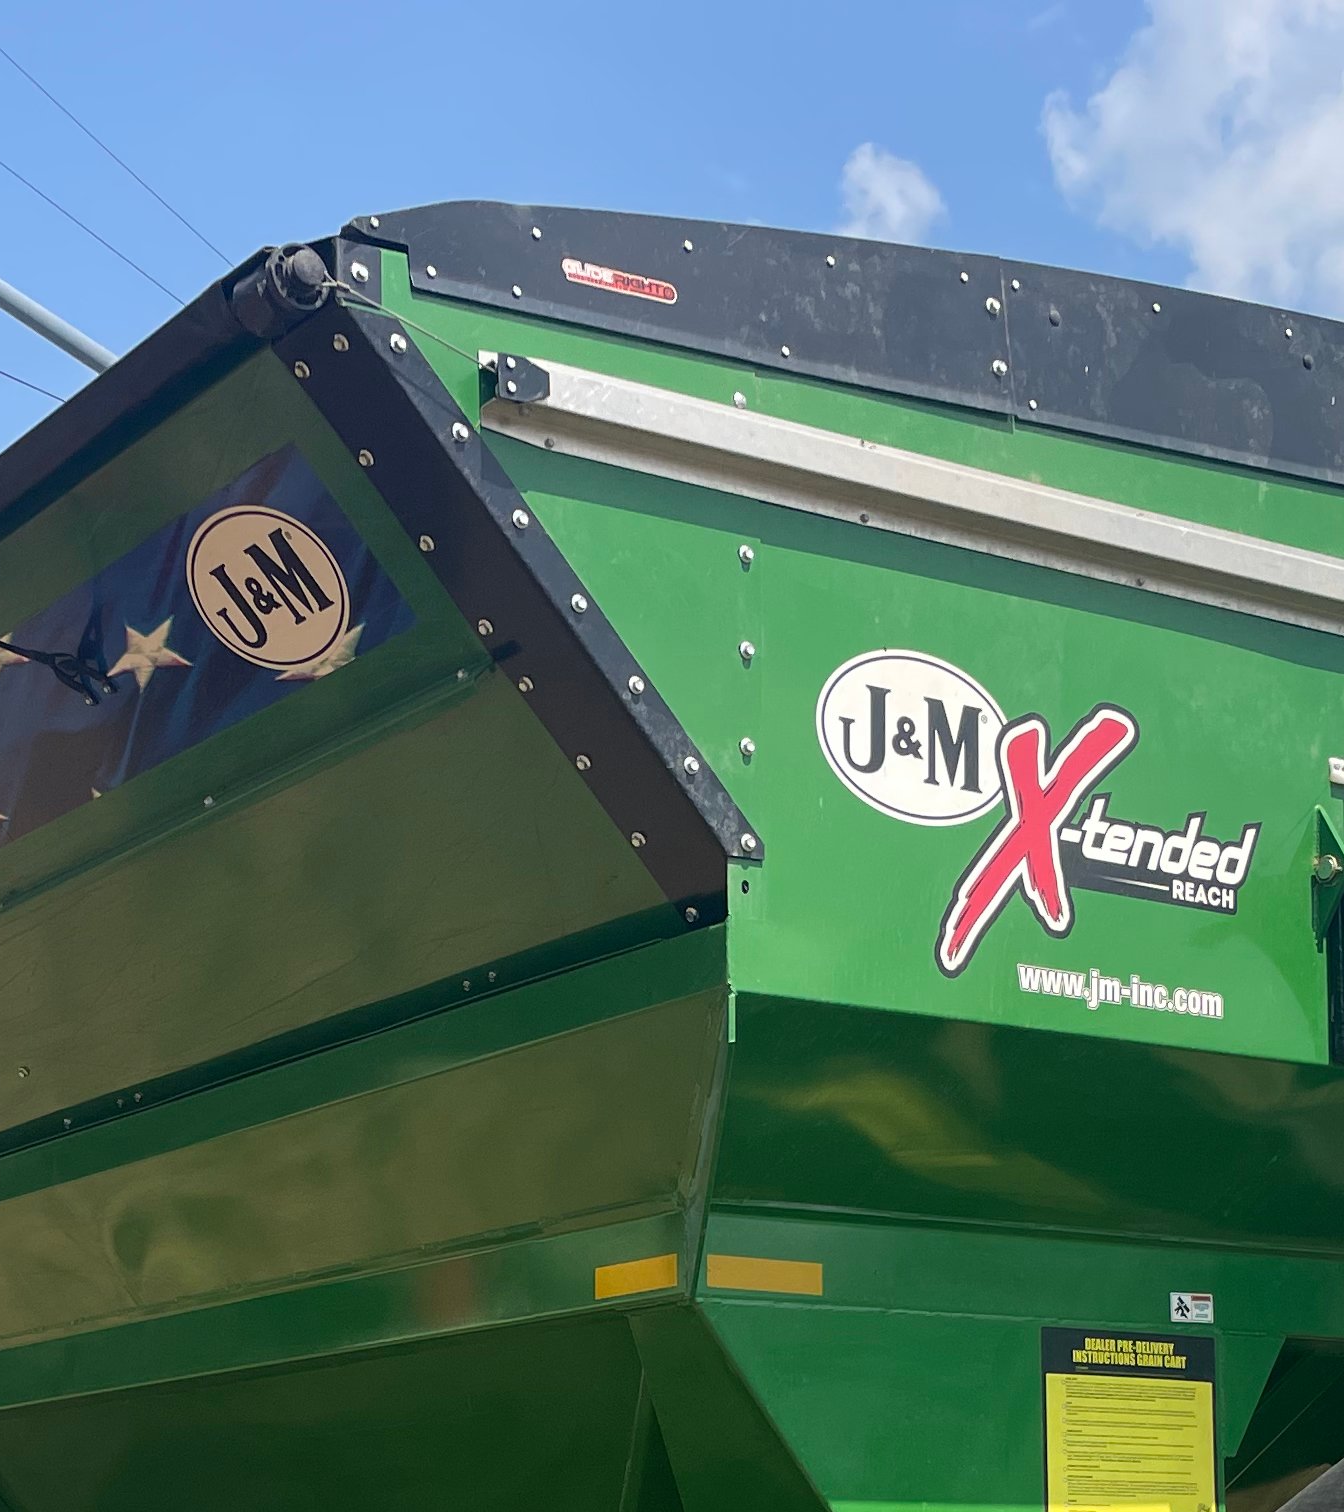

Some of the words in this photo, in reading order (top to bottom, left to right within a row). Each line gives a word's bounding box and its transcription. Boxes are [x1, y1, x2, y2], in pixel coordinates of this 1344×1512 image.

[208, 527, 334, 648] J&M
[838, 685, 984, 794] J&M
[1172, 880, 1235, 909] REACH
[1017, 963, 1224, 1019] www.jm-inc.com
[1072, 1350, 1136, 1366] INSTRUCTIONS
[1137, 1353, 1163, 1367] GRAIN
[1164, 1356, 1187, 1369] CART
[1084, 1337, 1116, 1351] DEALER
[1117, 1339, 1175, 1355] PRE-DELIVERY
